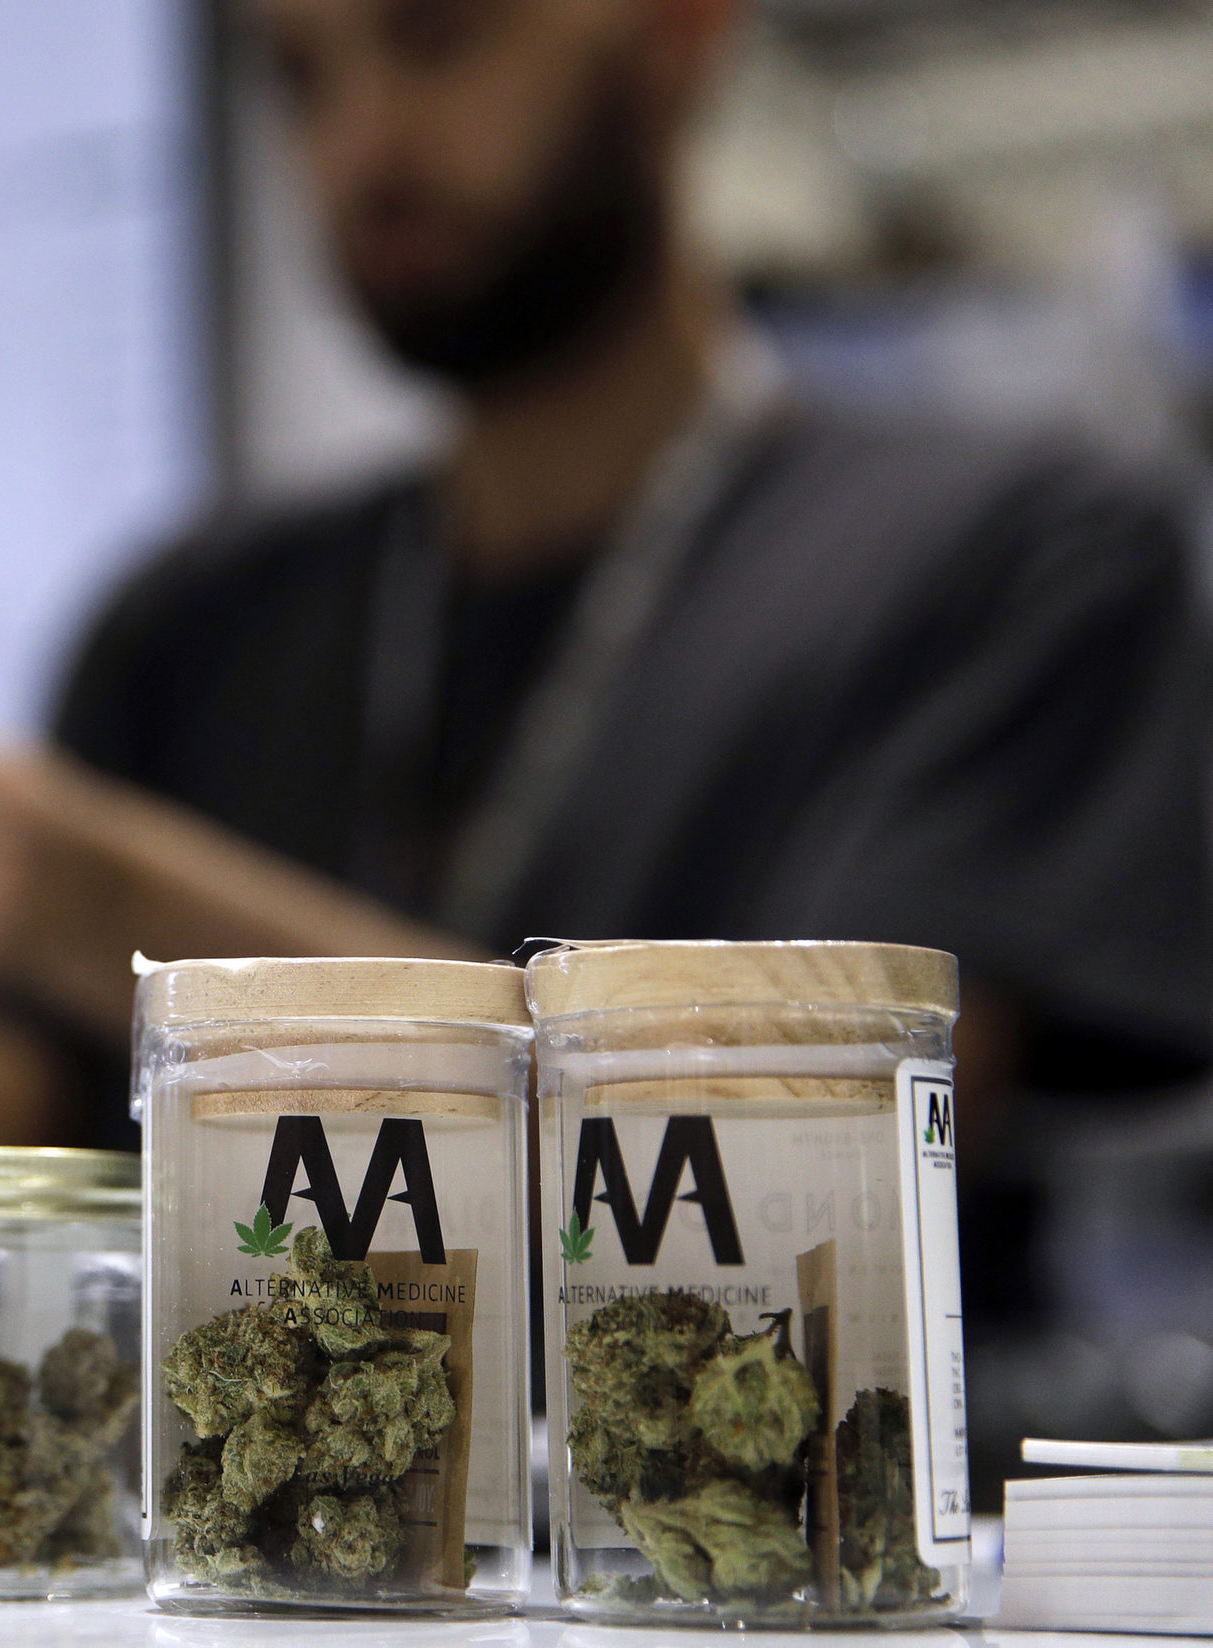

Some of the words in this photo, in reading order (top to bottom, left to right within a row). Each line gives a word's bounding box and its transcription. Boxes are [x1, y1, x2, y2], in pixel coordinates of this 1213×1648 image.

[230, 1278, 368, 1299] ALTERNATIVE
[377, 1281, 466, 1304] MEDICINE
[558, 1285, 659, 1304] ALTERNATIVE
[667, 1285, 773, 1307] MEDICINE
[283, 1306, 422, 1329] ASSOCIATION
